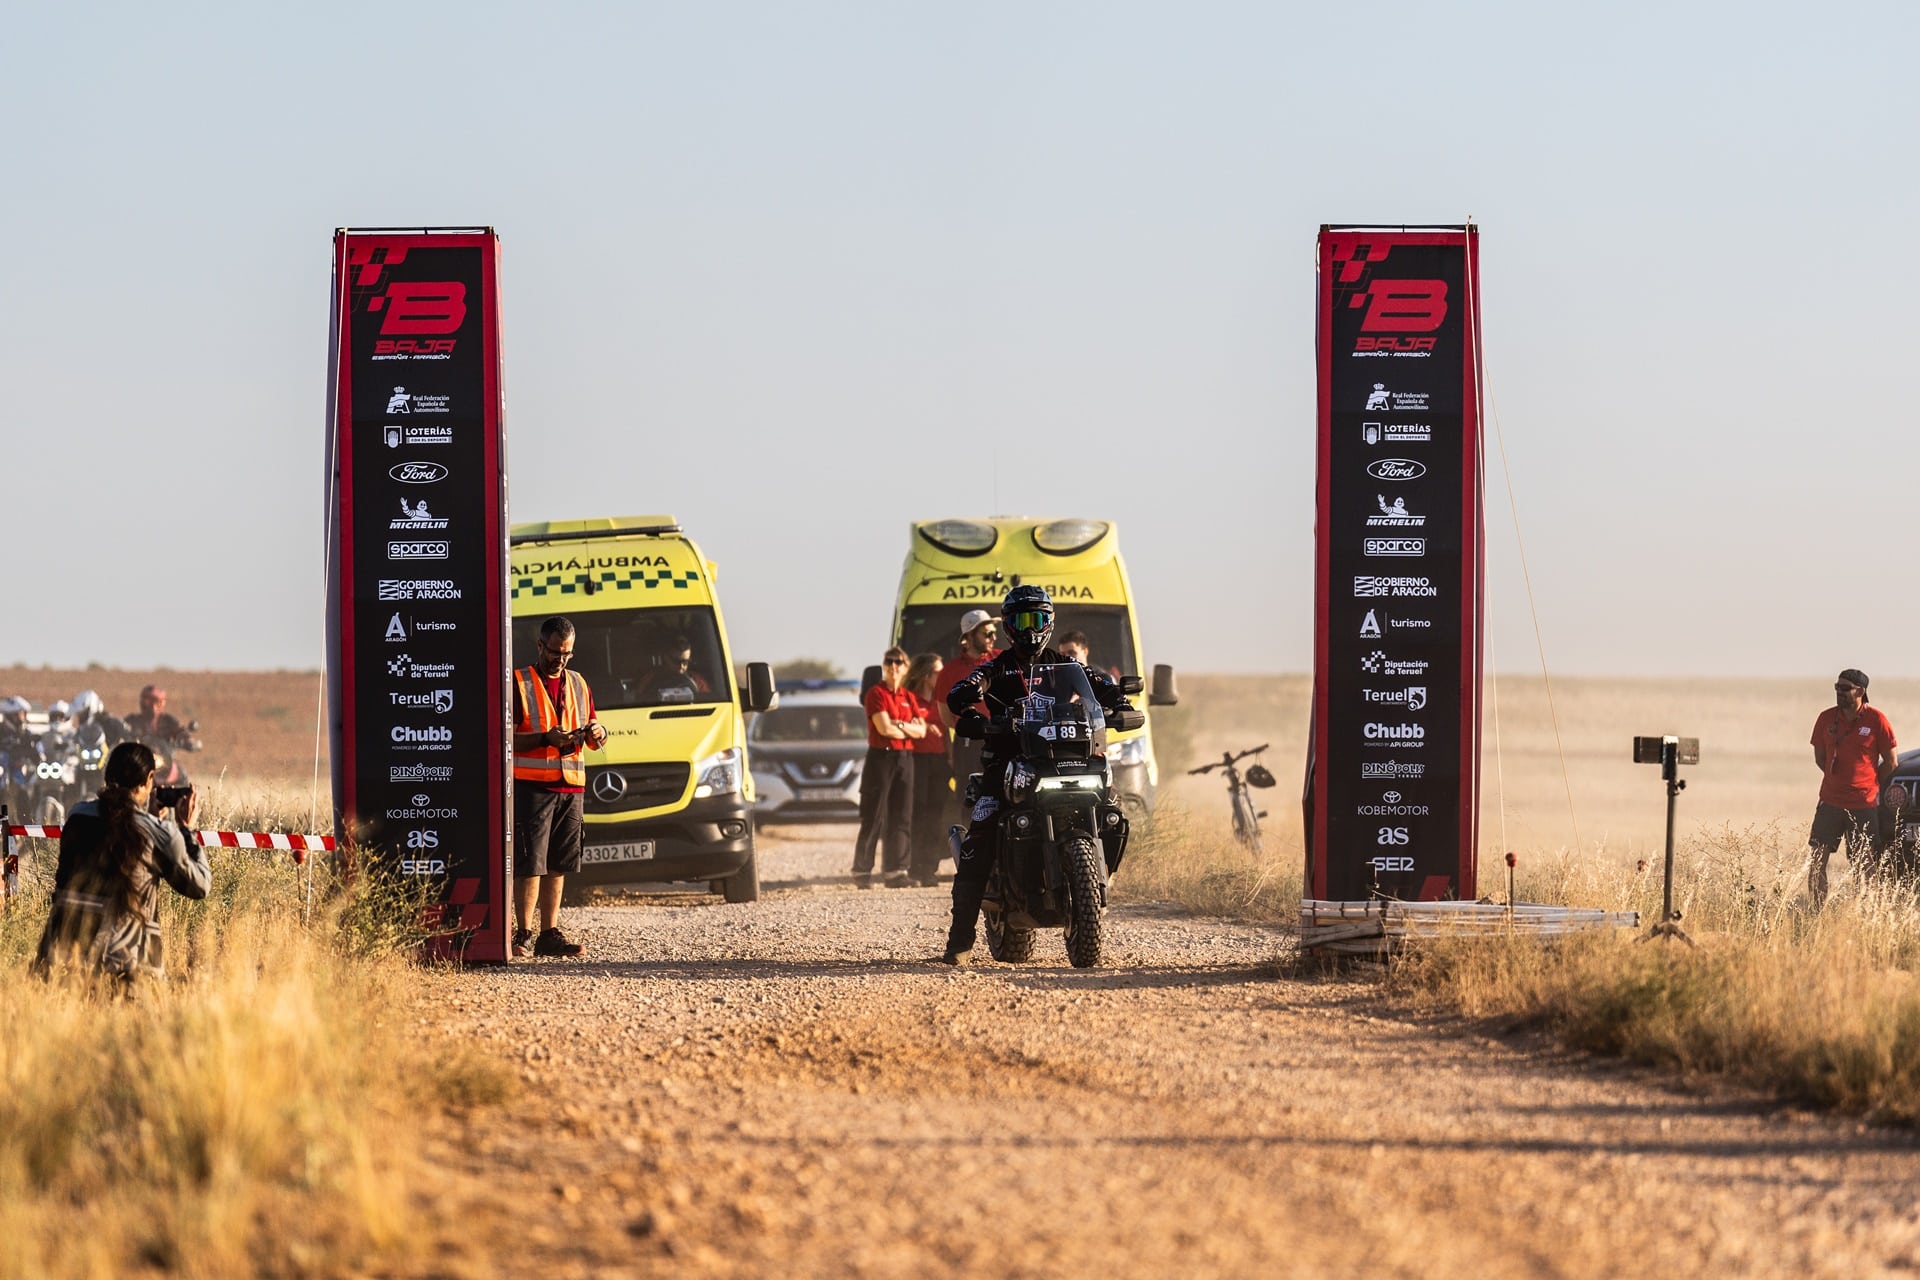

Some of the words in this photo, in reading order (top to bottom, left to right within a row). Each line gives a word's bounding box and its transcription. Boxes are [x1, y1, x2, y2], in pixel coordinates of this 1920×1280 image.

[374, 339, 456, 354] BAJA
[1355, 337, 1437, 351] BAJA
[405, 425, 453, 436] LOTERÍAS
[1384, 423, 1431, 433] LOTERÍAS
[400, 464, 438, 480] Ford
[1378, 461, 1415, 477] Ford
[389, 521, 448, 530] MICHELIN
[1366, 518, 1425, 527] MICHELIN
[390, 543, 446, 558] sparco
[1366, 540, 1422, 555] sparco
[399, 580, 454, 590] GOBIERNO
[1374, 577, 1430, 587] GOBIERNO
[399, 590, 414, 600] DE
[416, 589, 462, 600] ARAGON
[1374, 587, 1389, 597] DE
[1391, 587, 1437, 597] ARAGON
[415, 621, 457, 631] turismo
[1390, 618, 1431, 628] turismo
[410, 662, 455, 671] Diputación
[1384, 660, 1429, 669] Diputación
[389, 691, 434, 704] Teruel
[1362, 688, 1408, 702] Teruel
[391, 726, 453, 742] Chubb
[1060, 725, 1077, 739] 89
[1363, 722, 1425, 738] Chubb
[390, 762, 454, 777] DINÓPOLIS
[1361, 759, 1425, 774] DINÓPOLIS
[386, 808, 459, 819] KOBEMOTOR
[1357, 805, 1429, 816] KOBEMOTOR
[407, 829, 439, 848] as
[1377, 826, 1410, 845] as
[585, 847, 619, 862] 3302
[623, 844, 648, 859] KLP
